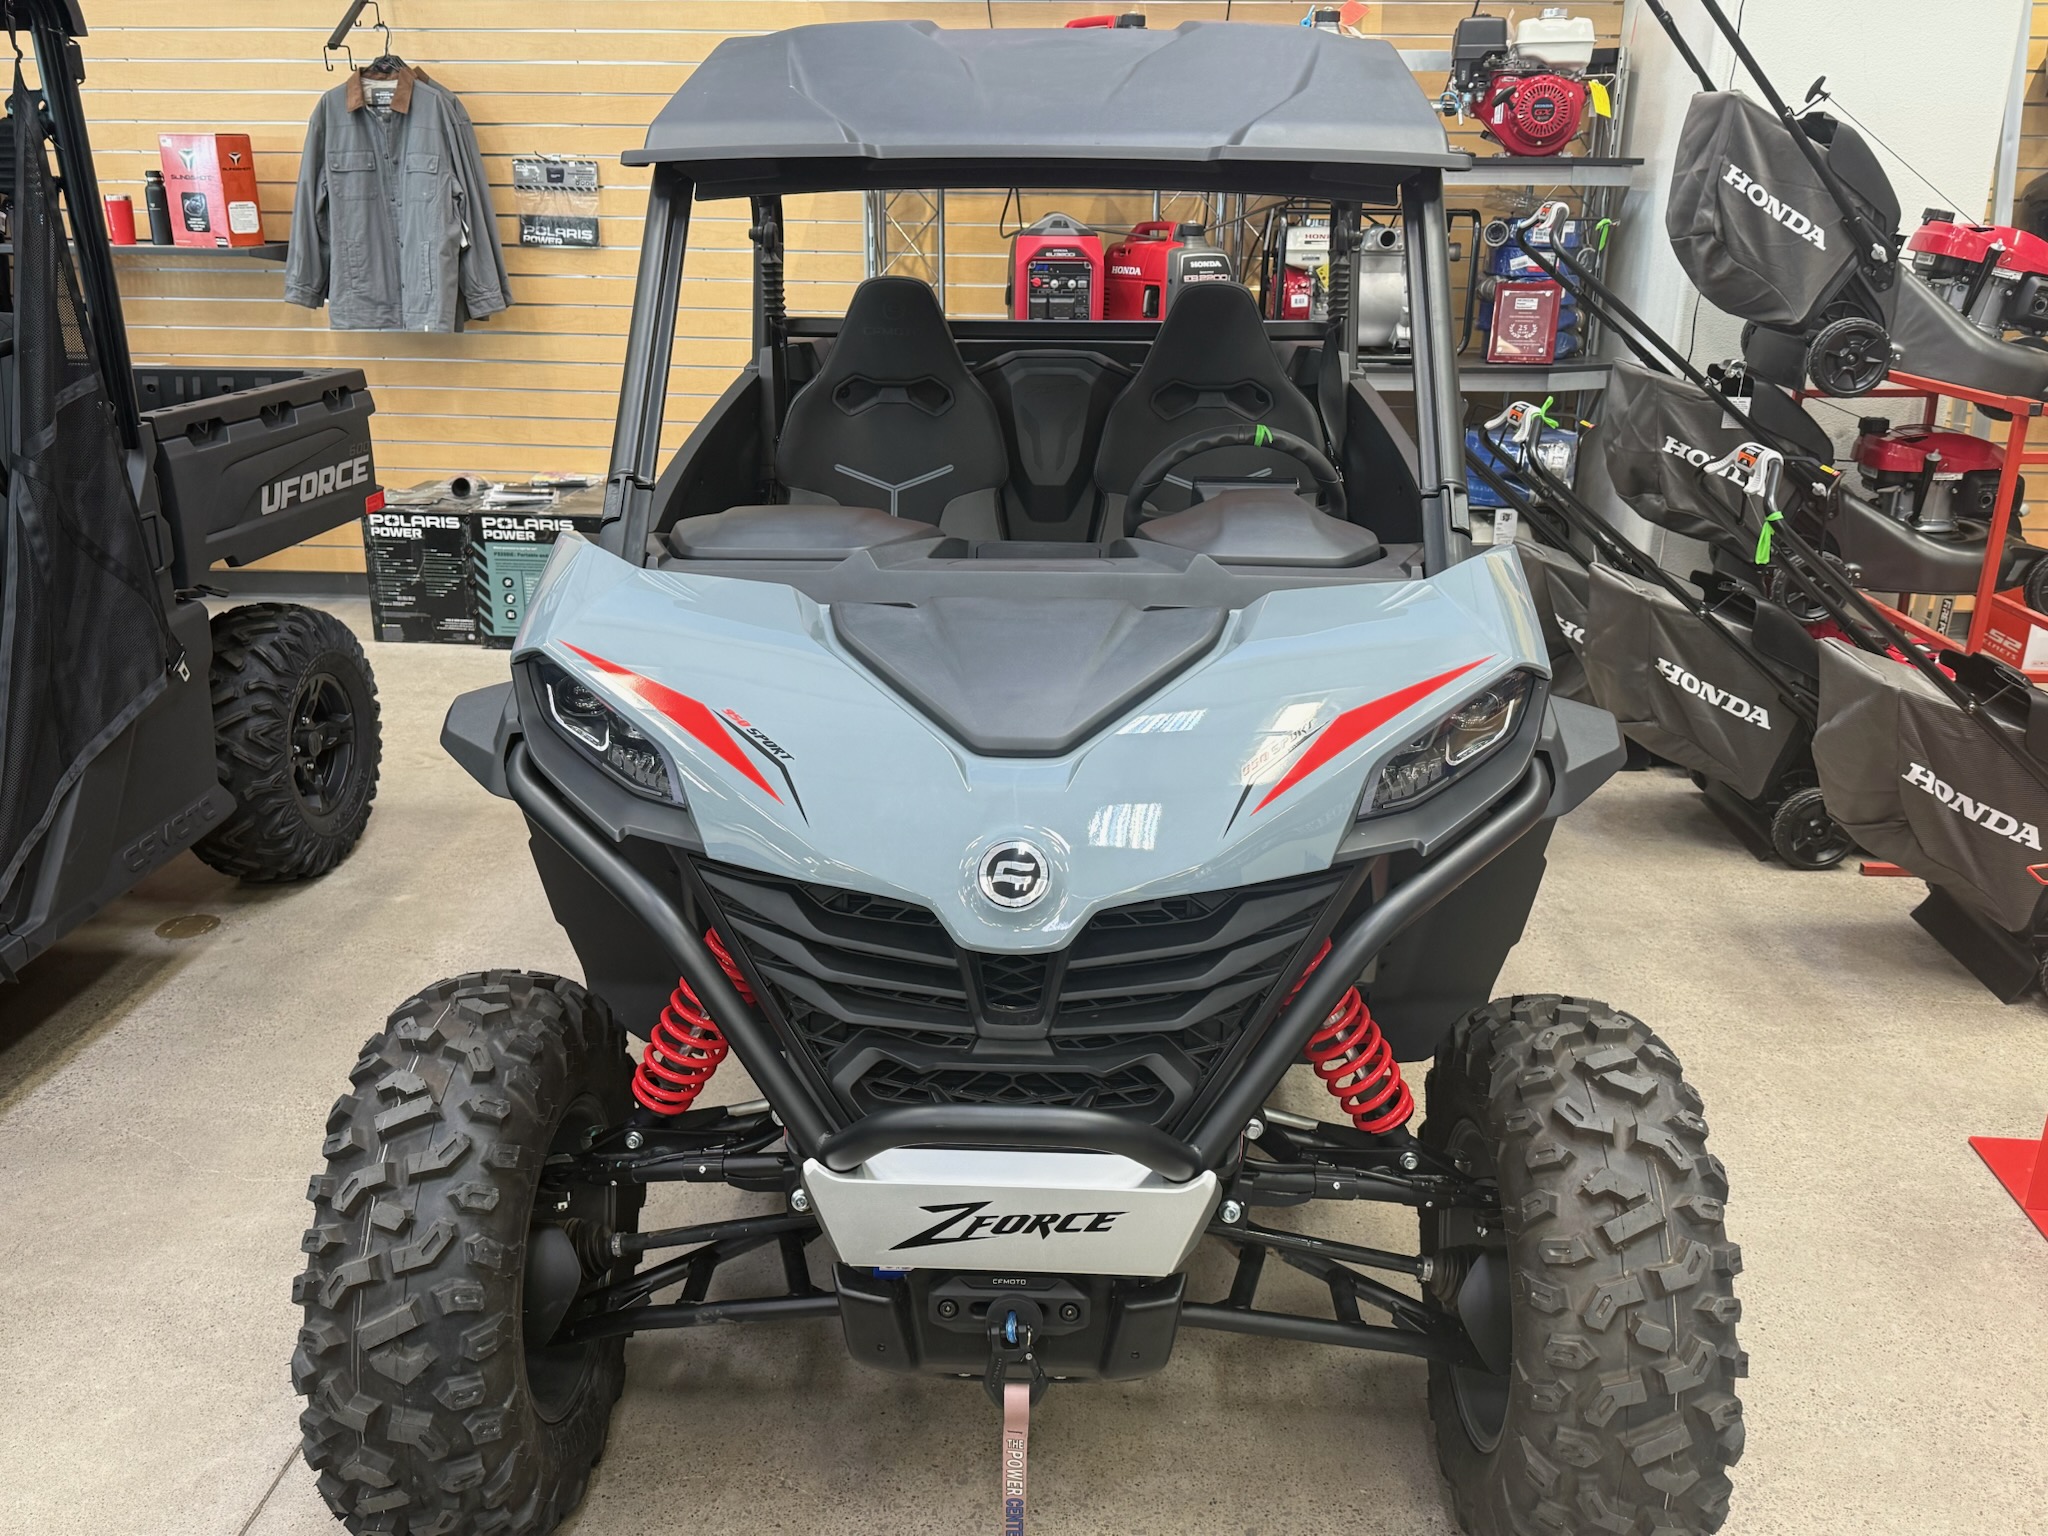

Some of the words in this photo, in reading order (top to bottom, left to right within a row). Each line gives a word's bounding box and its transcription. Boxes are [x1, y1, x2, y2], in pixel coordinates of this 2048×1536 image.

[1722, 163, 1827, 251] HONDA
[523, 225, 593, 240] POLARIS
[523, 234, 563, 245] POWER
[1111, 265, 1142, 276] HONDA
[1190, 260, 1222, 268] HONDA
[349, 440, 370, 456] 600
[261, 454, 370, 516] UFORCE
[369, 513, 460, 529] POLARIS
[481, 516, 574, 531] POLARIS
[370, 526, 422, 538] POWER
[483, 529, 536, 541] POWER
[1984, 628, 2023, 653] S2
[1655, 657, 1771, 731] HONDA
[746, 727, 795, 760] SPORT
[1901, 762, 2043, 852] HONDA
[888, 1200, 1131, 1251] ZFORCE
[1006, 1439, 1024, 1449] THE
[1006, 1450, 1023, 1496] POWER
[1006, 1498, 1024, 1536] CENTE
